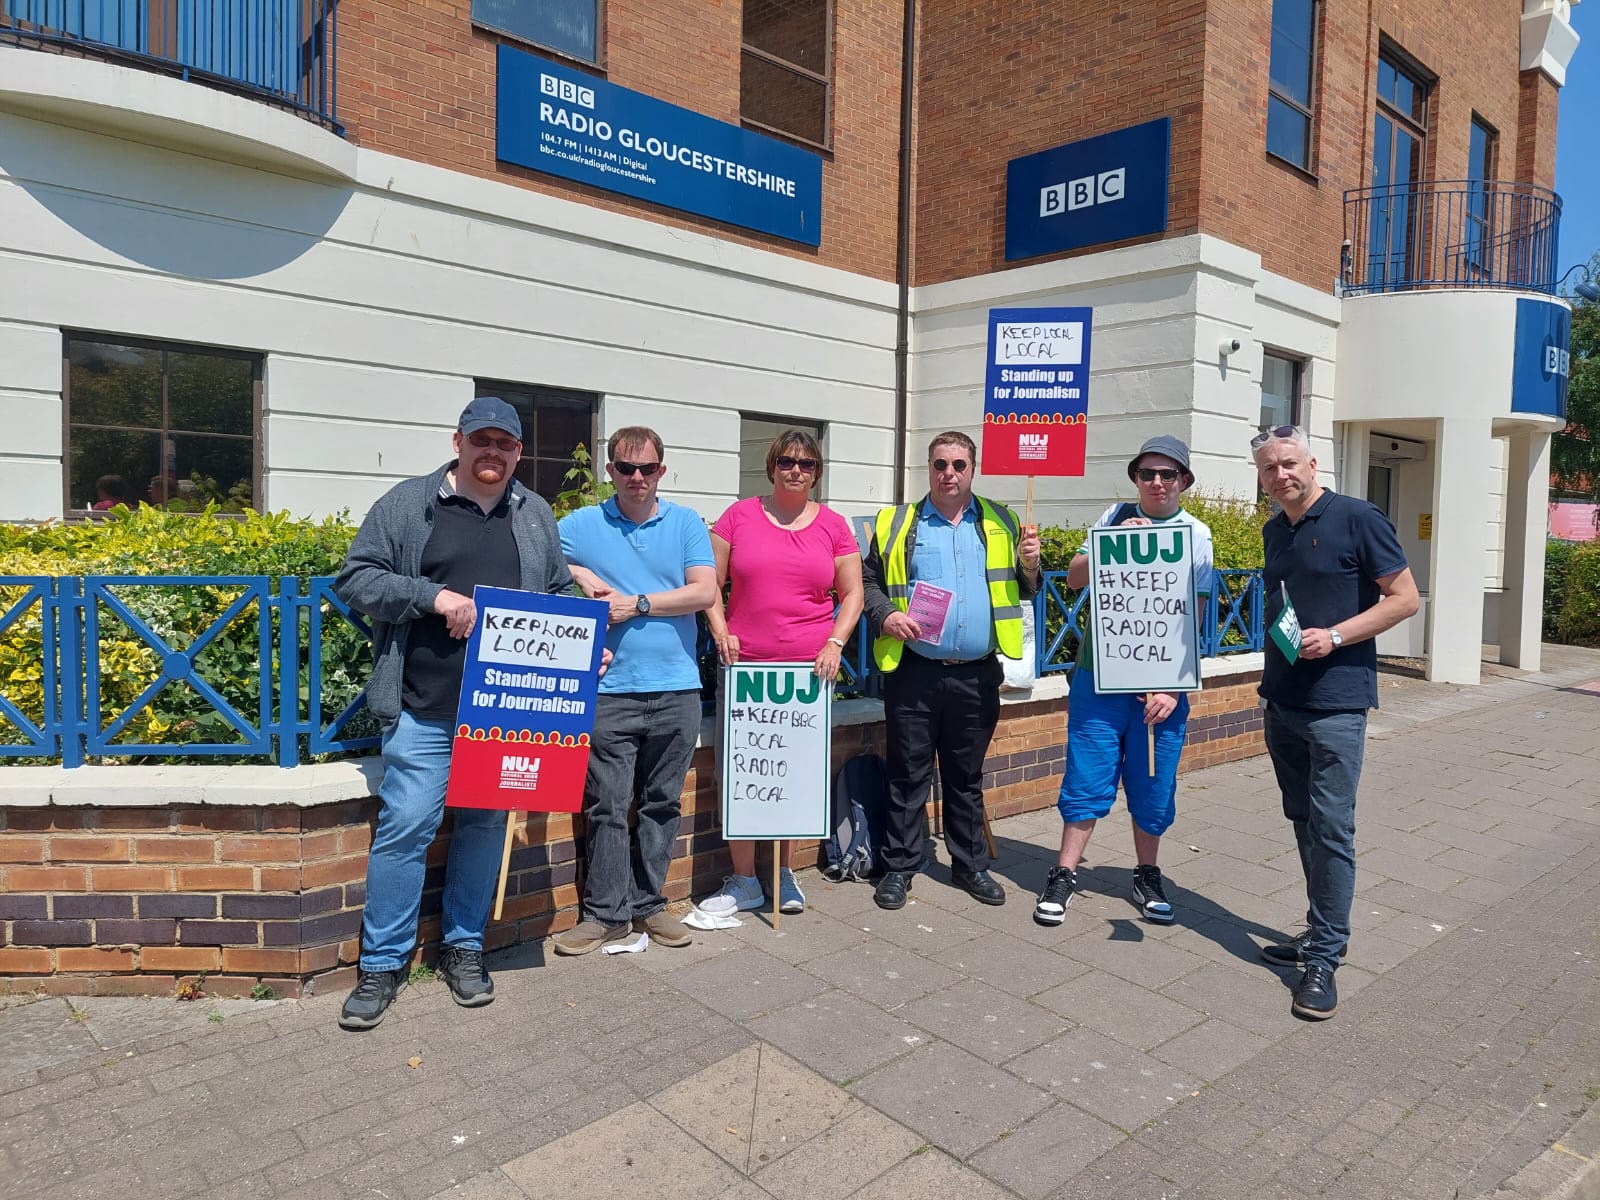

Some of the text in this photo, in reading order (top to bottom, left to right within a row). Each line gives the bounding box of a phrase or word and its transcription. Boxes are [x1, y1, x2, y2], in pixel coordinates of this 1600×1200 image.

[541, 74, 594, 109] BBC
[540, 102, 796, 198] RADIO GLOUCESTERSHIRE
[541, 131, 648, 171] 104.7 FM 1413 AM Digital
[540, 143, 656, 185] bbc.co.uk/radiogloucestershire
[1041, 168, 1125, 217] BBC
[1002, 326, 1041, 340] KEEP
[1005, 341, 1059, 359] LOCAL
[1545, 346, 1570, 377] BB
[1001, 369, 1074, 384] Standing up
[993, 386, 1080, 399] for Journalism
[1019, 433, 1049, 446] NUJ
[1099, 531, 1184, 566] NUJ
[1099, 593, 1190, 616] BBC LOCAL
[485, 613, 590, 641] KEEP LOCAL
[1101, 617, 1168, 638] RADIO
[493, 635, 559, 661] LOCAL
[1106, 643, 1173, 663] LOCAL
[484, 668, 580, 694] Standing up
[736, 671, 820, 704] NUJ
[472, 690, 586, 715] for Journalism
[791, 710, 817, 730] BBC
[734, 729, 790, 750] LOCAL
[502, 755, 541, 773] NUJ
[732, 753, 788, 777] RADIO
[733, 781, 788, 803] LOCAL
